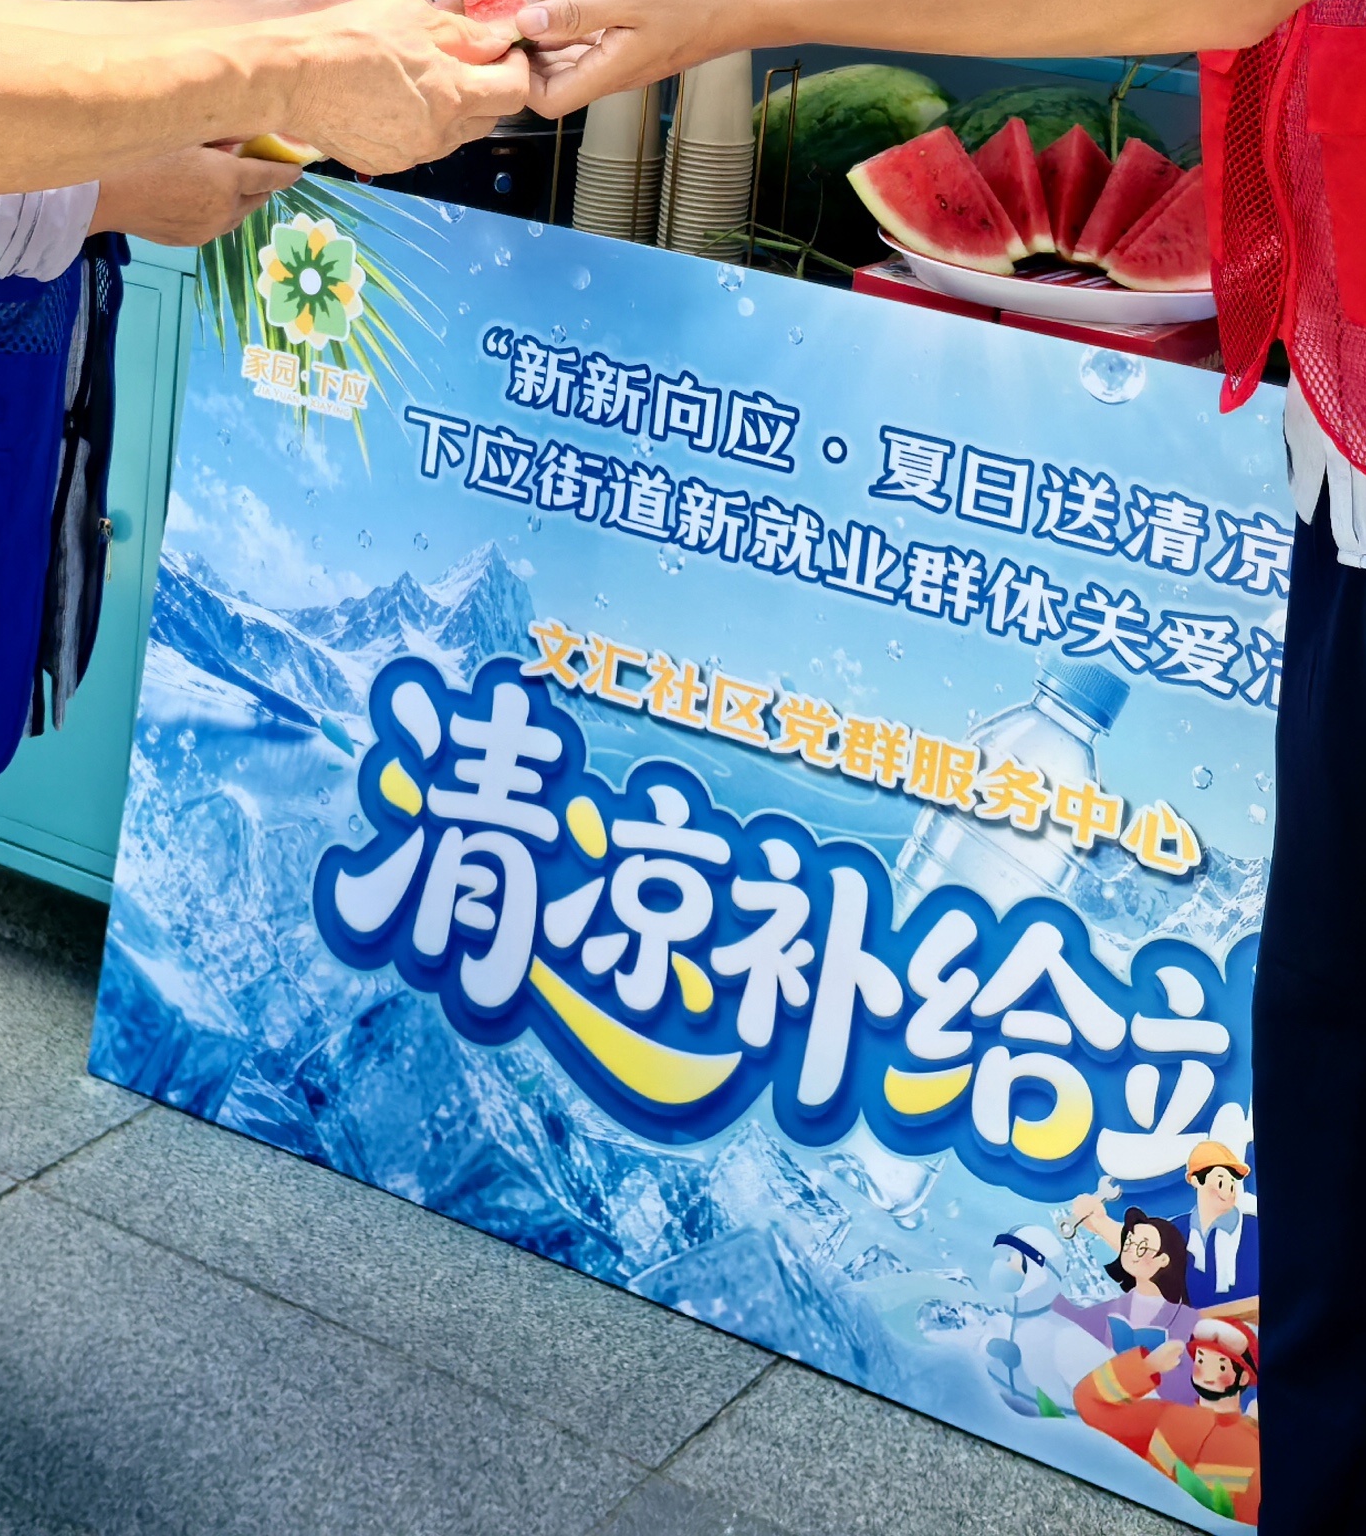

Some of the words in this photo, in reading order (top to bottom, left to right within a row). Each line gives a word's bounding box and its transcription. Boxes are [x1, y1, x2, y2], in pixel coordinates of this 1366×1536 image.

[527, 620, 1202, 875] 文汇社区党群服务中心
